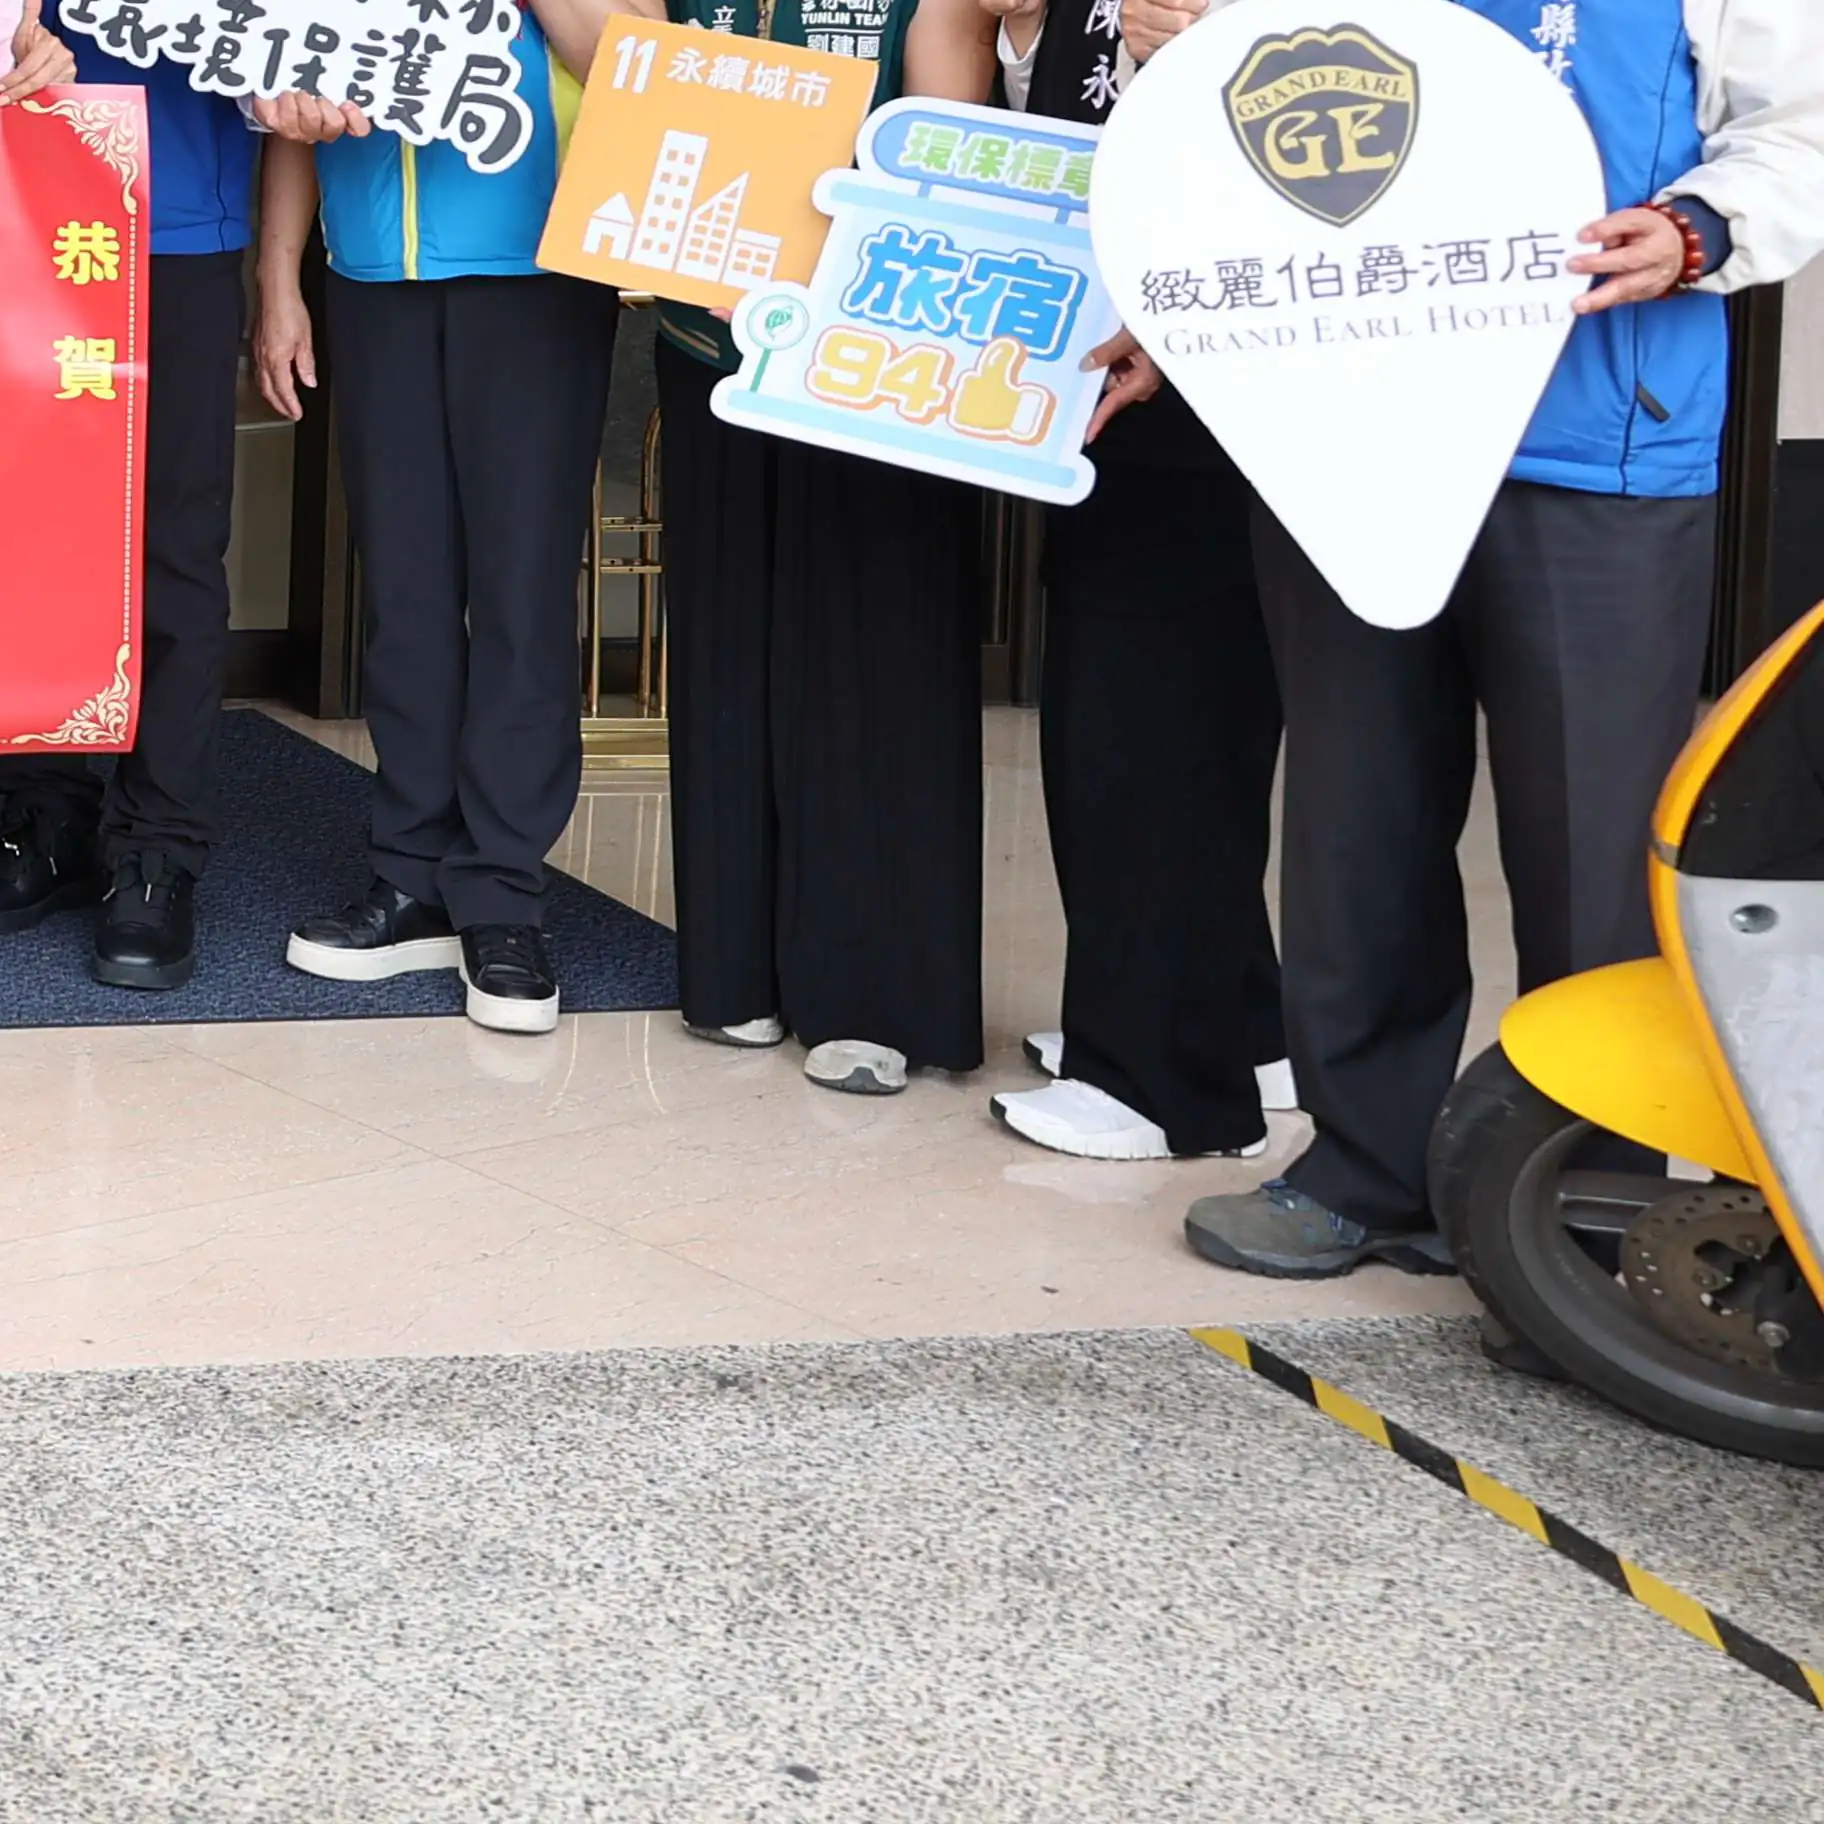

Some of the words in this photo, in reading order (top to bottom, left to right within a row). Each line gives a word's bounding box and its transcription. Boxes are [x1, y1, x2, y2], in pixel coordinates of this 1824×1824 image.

[801, 12, 850, 26] YUNLIN
[612, 35, 658, 94] 11
[666, 46, 832, 107] 永續城市
[1236, 71, 1327, 118] GRAND
[1334, 70, 1407, 98] EARL
[1264, 102, 1396, 180] GE
[53, 220, 121, 401] 恭賀
[841, 222, 1089, 362] 旅宿
[1140, 229, 1566, 316] 緻麗伯爵酒店
[1163, 323, 1298, 357] GRAND
[1314, 314, 1412, 345] EARL
[1427, 302, 1568, 335] HOTEL
[805, 324, 955, 425] 94
